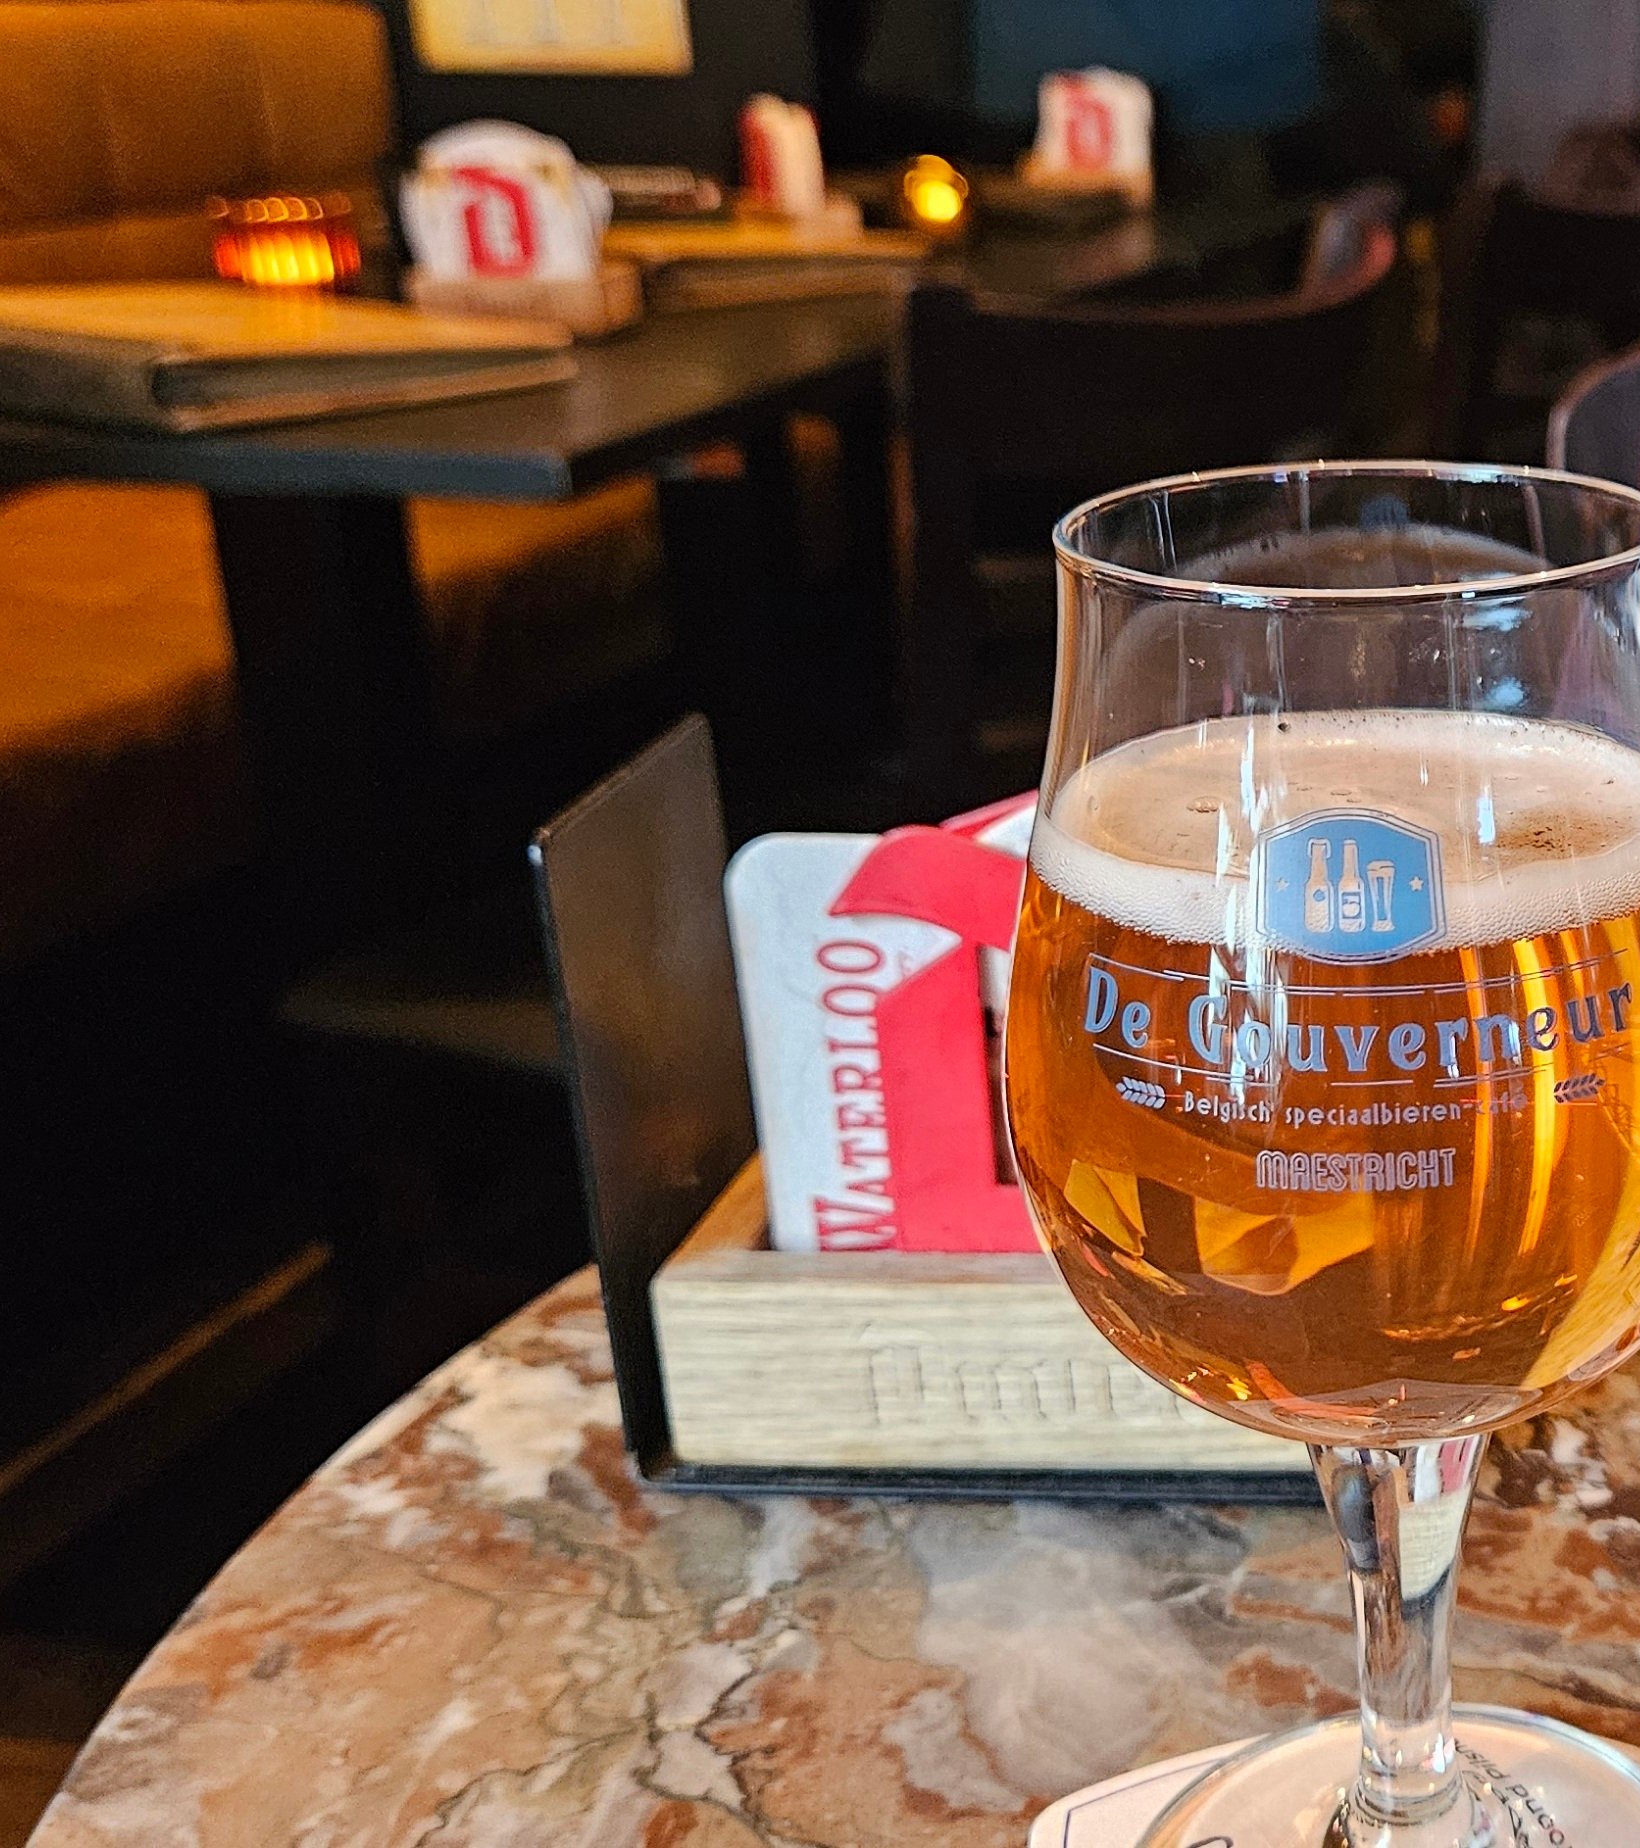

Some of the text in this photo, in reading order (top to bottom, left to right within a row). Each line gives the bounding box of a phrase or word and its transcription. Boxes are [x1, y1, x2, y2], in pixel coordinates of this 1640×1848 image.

[1084, 965, 1635, 1073] De Gouverneur
[1184, 1090, 1272, 1125] Belgisch
[1256, 1148, 1457, 1192] MAESTRICHT
